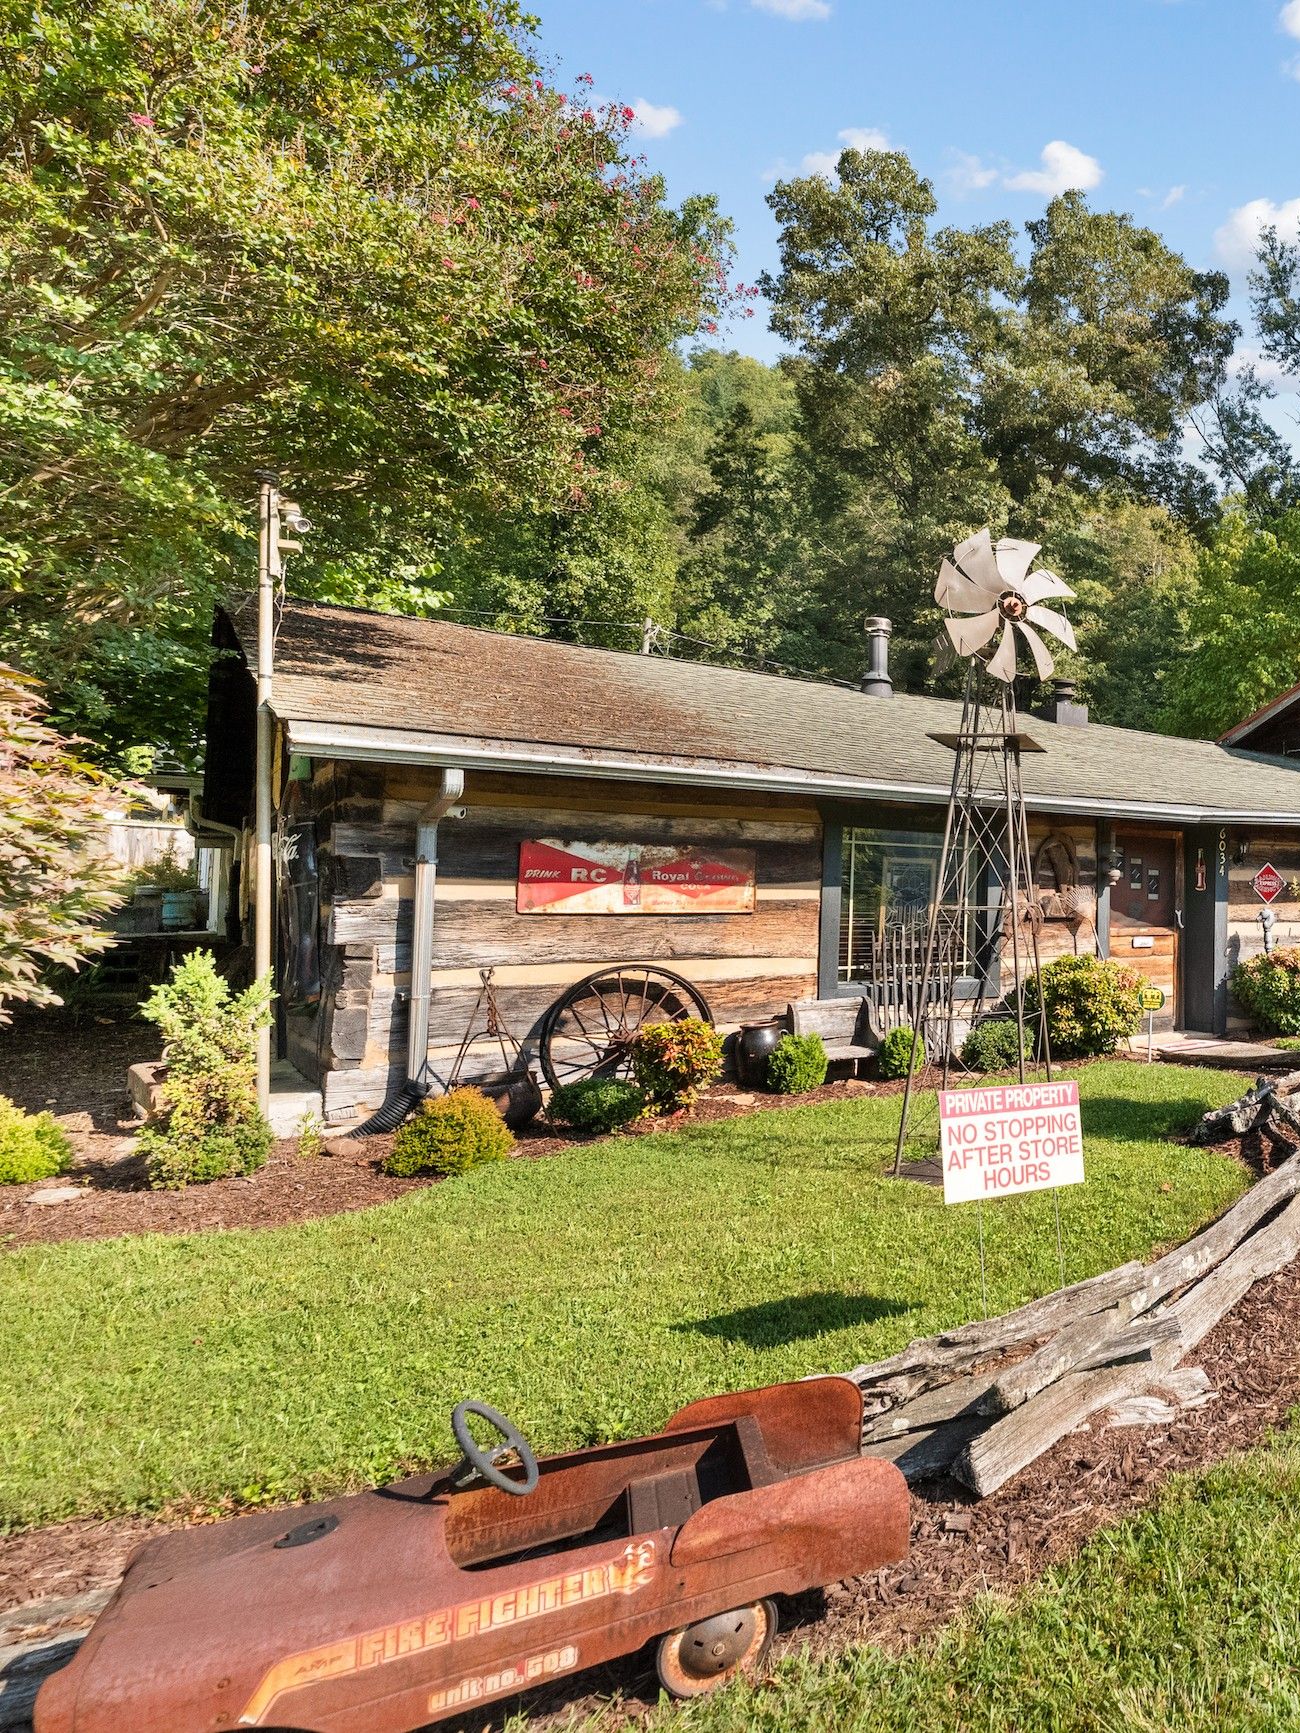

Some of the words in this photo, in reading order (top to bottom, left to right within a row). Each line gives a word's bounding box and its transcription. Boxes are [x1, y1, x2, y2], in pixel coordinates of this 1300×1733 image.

[524, 869, 561, 879] DRINK
[570, 866, 608, 883] RC
[652, 870, 690, 883] Royal
[945, 1091, 1003, 1114] PRIVATE
[1005, 1085, 1073, 1109] PROPERTY
[947, 1123, 978, 1146] NO
[984, 1112, 1077, 1142] STOPPING
[948, 1143, 1012, 1171] AFTER
[1019, 1135, 1080, 1161] STORE
[984, 1162, 1051, 1191] HOURS
[360, 1614, 448, 1664] FIRE
[456, 1567, 606, 1638] FIGHTER
[431, 1677, 480, 1710] unit
